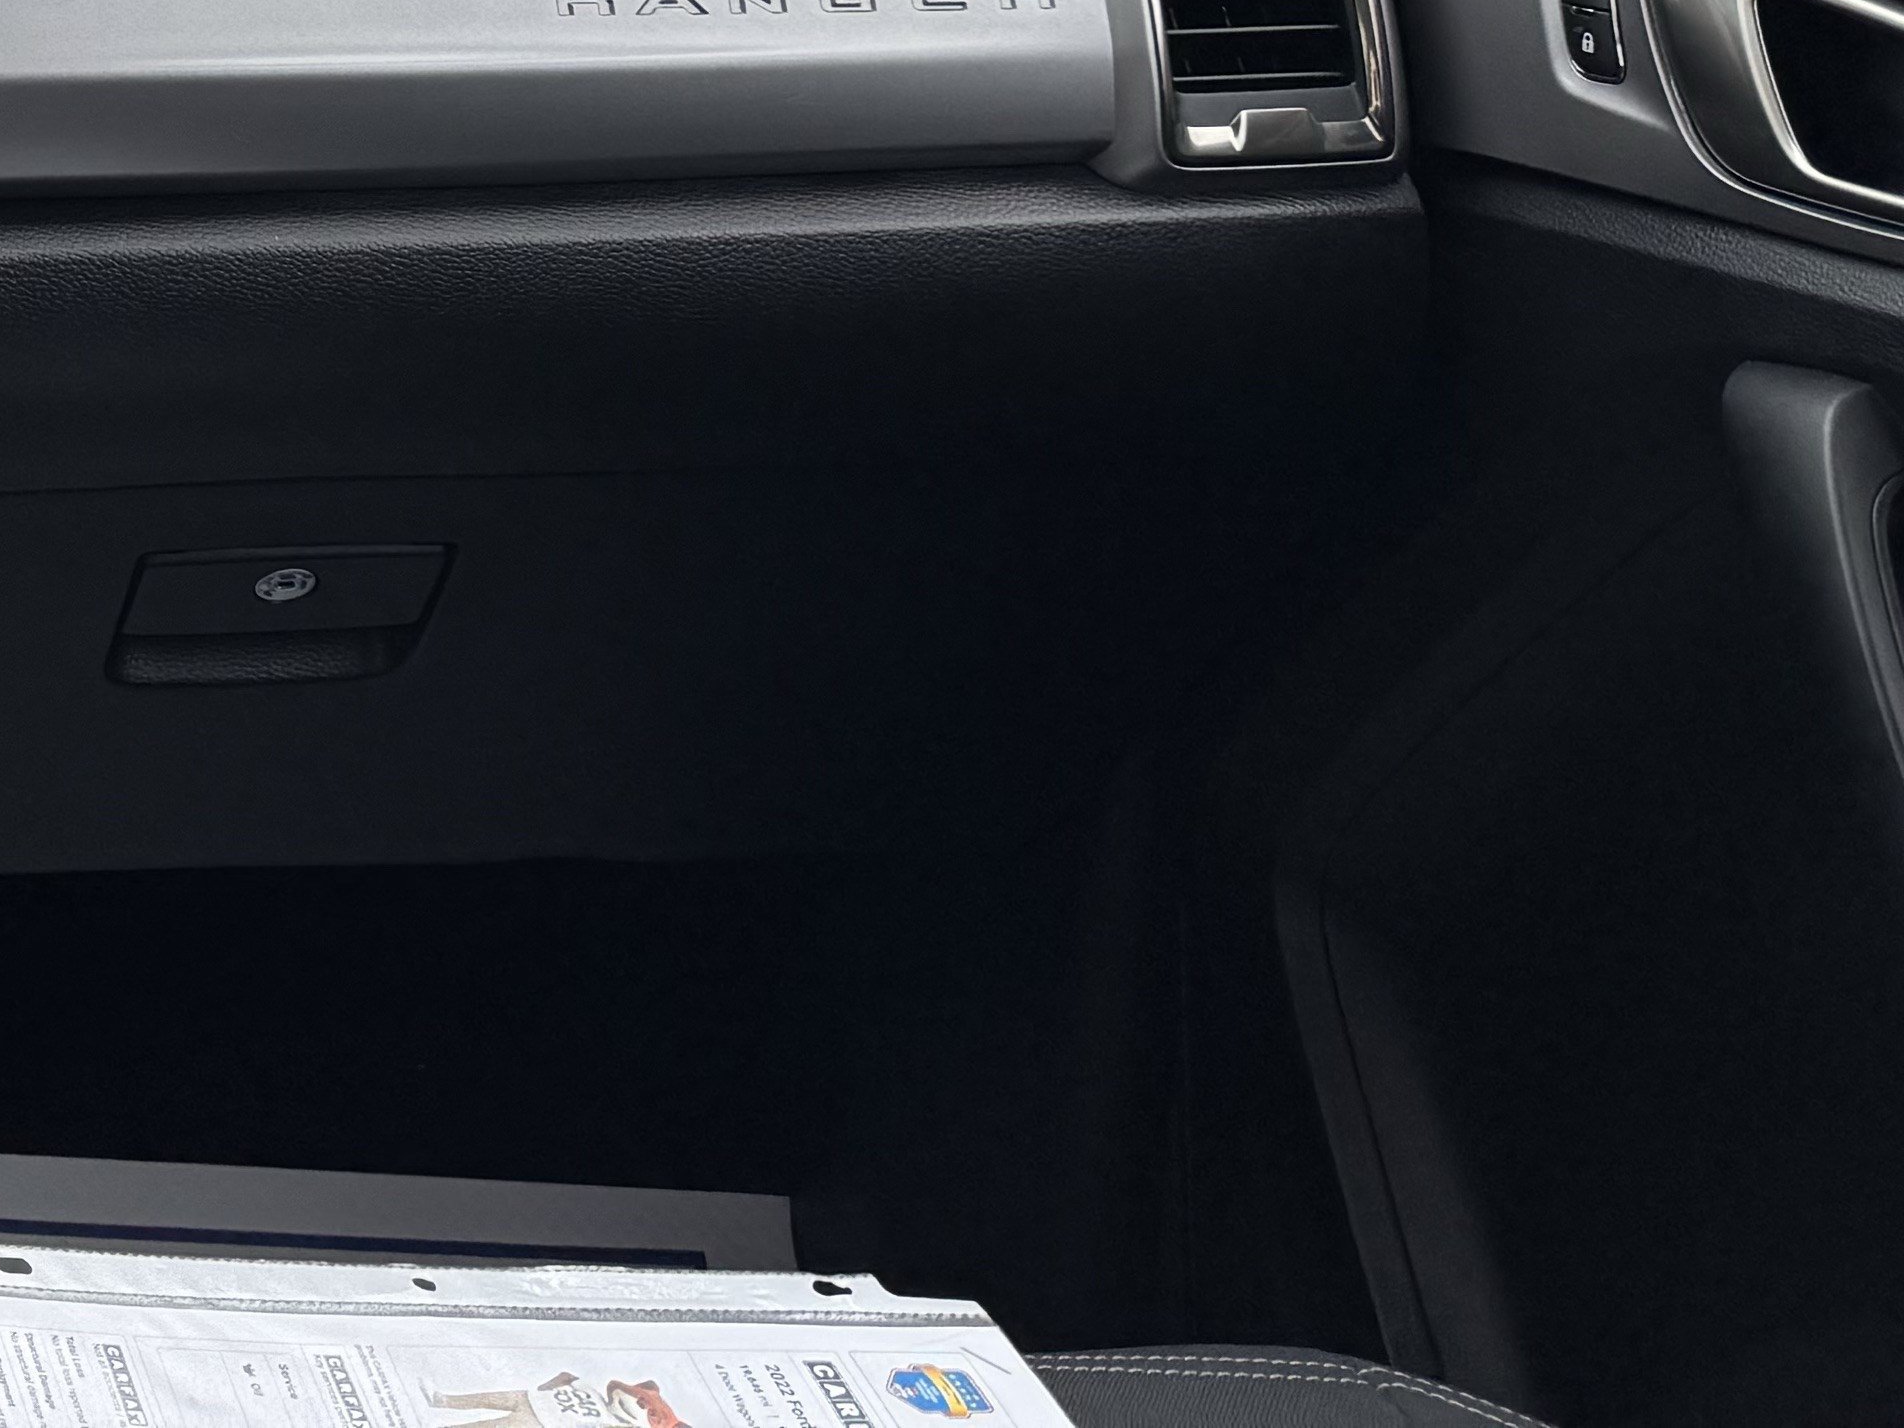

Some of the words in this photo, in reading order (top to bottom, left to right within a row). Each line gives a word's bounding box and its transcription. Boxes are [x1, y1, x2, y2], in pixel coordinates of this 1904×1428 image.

[104, 1344, 148, 1427] CARFAX
[277, 1363, 299, 1399] Service
[763, 1364, 796, 1396] 2022
